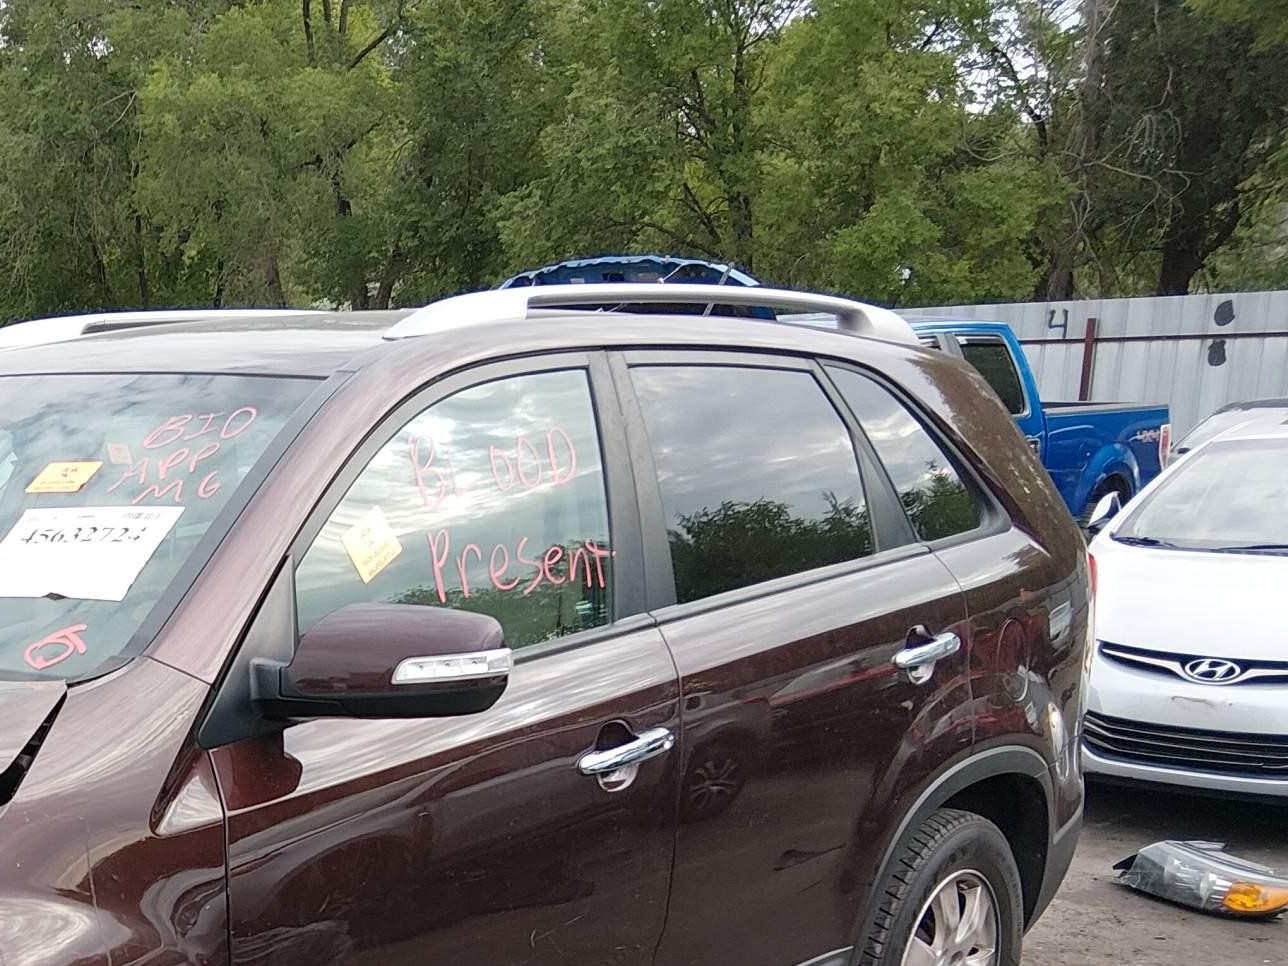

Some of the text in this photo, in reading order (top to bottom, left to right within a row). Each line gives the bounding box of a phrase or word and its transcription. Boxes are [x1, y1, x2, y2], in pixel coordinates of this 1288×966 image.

[1047, 308, 1069, 338] 4
[143, 406, 257, 449] BIO
[426, 528, 616, 604] Present
